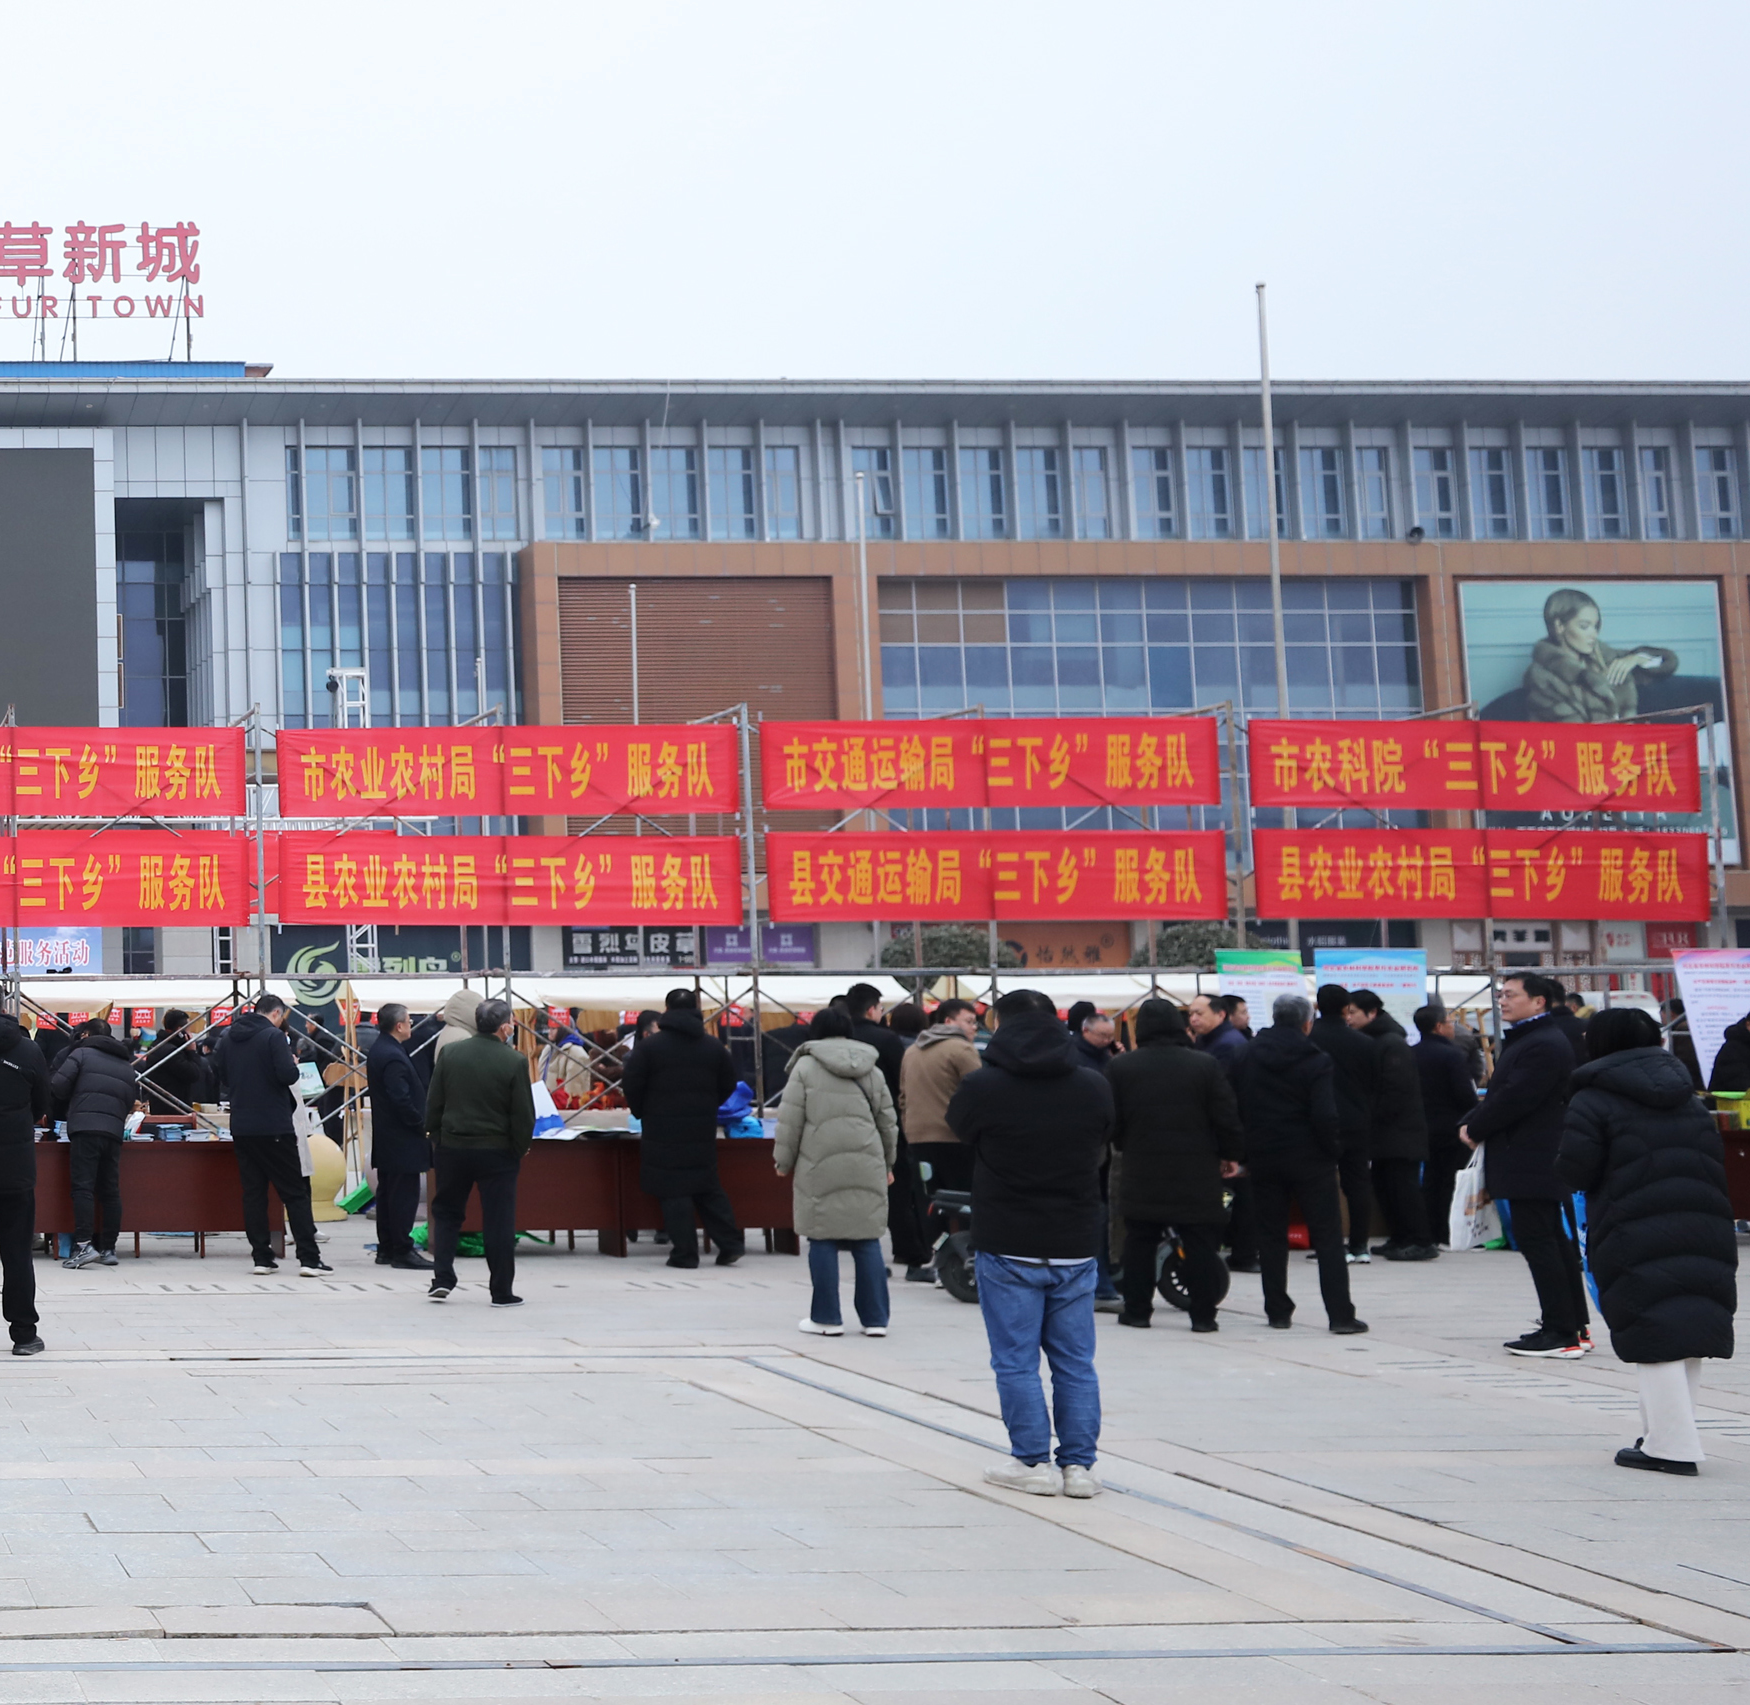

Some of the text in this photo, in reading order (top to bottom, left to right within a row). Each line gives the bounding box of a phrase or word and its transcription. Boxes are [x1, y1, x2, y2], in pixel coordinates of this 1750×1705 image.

[87, 294, 205, 319] TOWN
[300, 741, 714, 801] 市农业农村局“三下乡”服务队
[783, 733, 1195, 793] 市交通运输局“三下乡”服务队
[1270, 737, 1678, 797] 市农科院“三下乡”服务队
[302, 853, 718, 910] 县农业农村局“三下乡”服务队
[789, 847, 1202, 905] 县交通运输局“三下乡”服务队
[1278, 845, 1684, 904] 县农业农村局“三下乡”服务队
